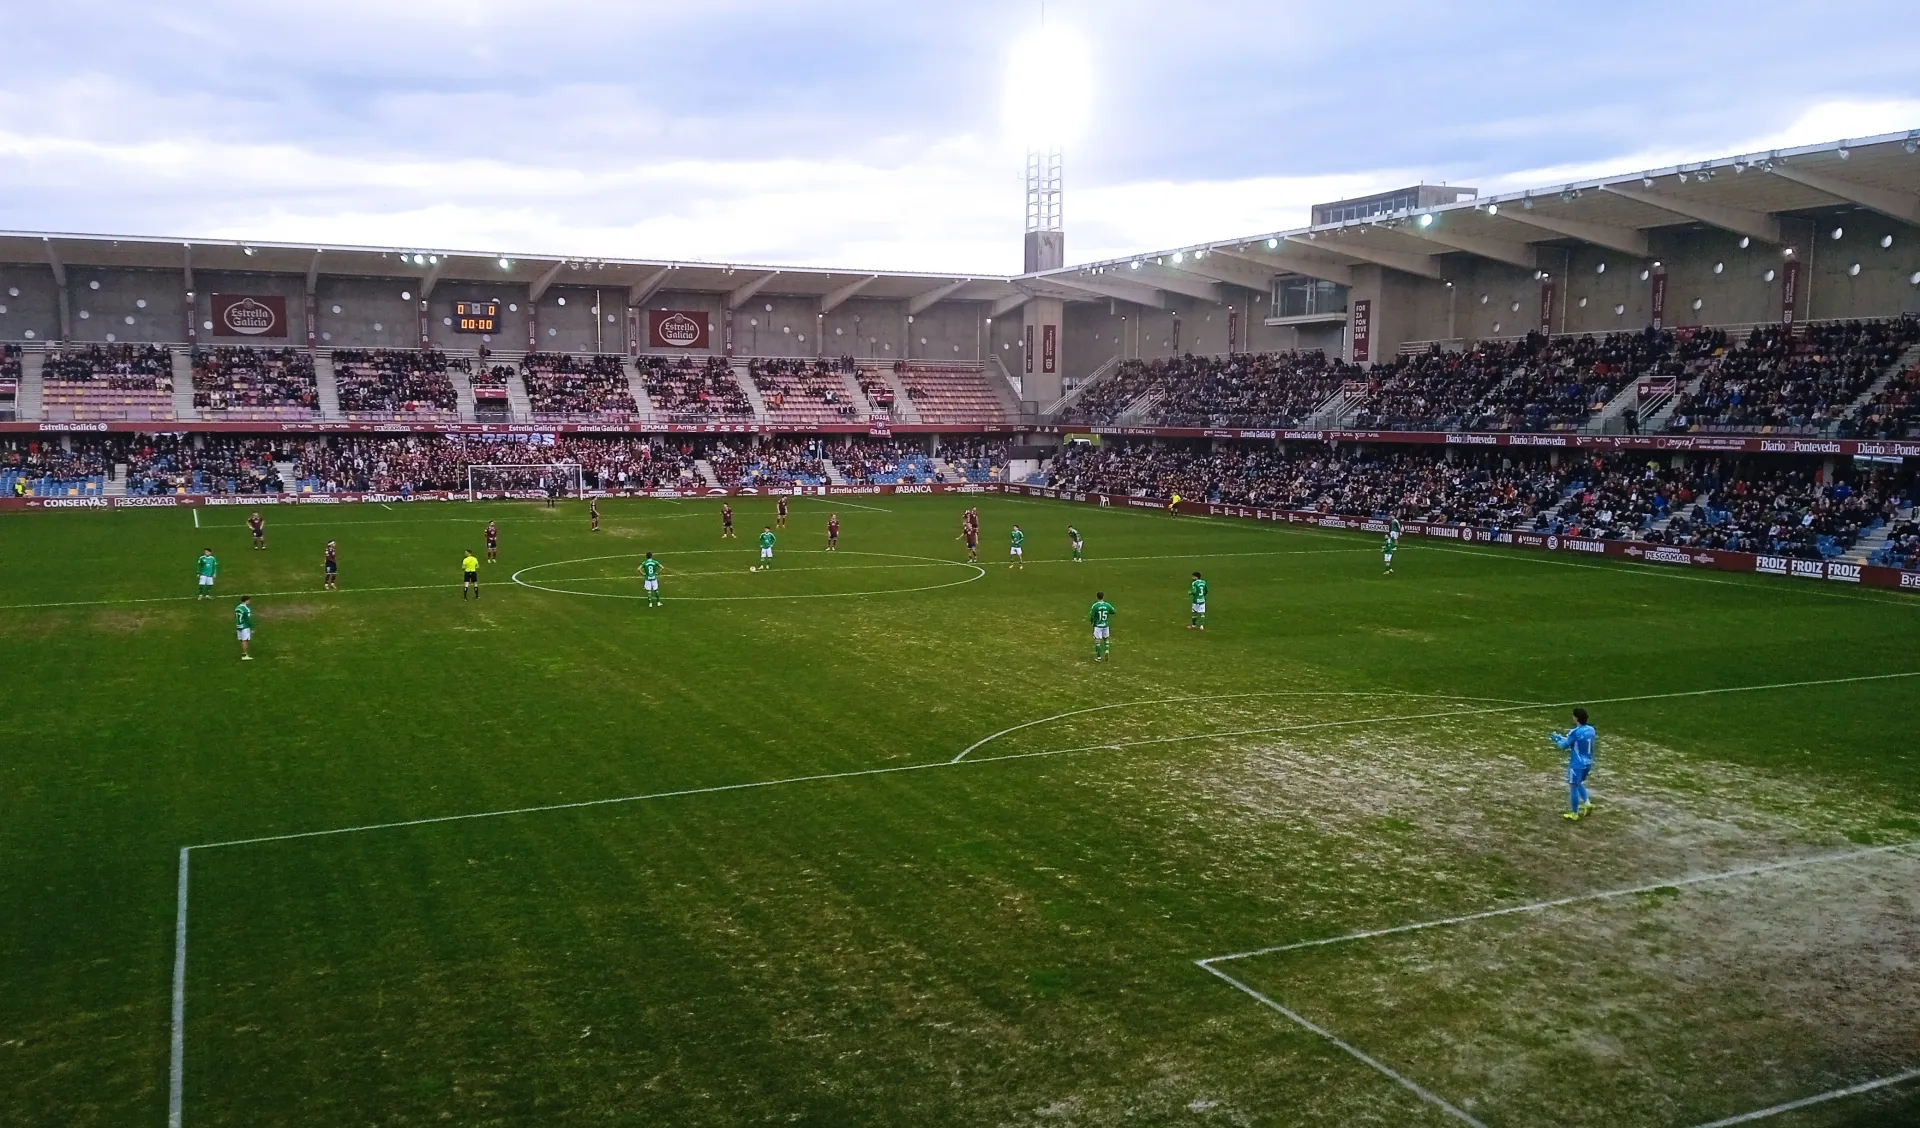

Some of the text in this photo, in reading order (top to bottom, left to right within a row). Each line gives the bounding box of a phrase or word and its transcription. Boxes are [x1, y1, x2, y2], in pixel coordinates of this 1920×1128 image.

[231, 308, 268, 319] Estrella
[457, 304, 464, 315] 0
[488, 305, 495, 316] 0
[233, 317, 267, 327] Galicia
[664, 322, 695, 331] Estrella
[1355, 318, 1366, 326] PON
[1355, 325, 1367, 333] TEVE
[666, 330, 693, 340] Galicia
[40, 423, 69, 431] Estrella
[508, 424, 556, 432] Estrella Galicia
[1240, 430, 1256, 438] Estrella
[1302, 431, 1317, 439] Galicia
[1446, 434, 1462, 443] Diario
[1467, 435, 1496, 444] Pontevedra
[1509, 435, 1527, 445] Diario
[1533, 436, 1566, 446] Pontevedra
[1760, 440, 1785, 451] Diario
[1793, 442, 1840, 453] Pontevedra
[1857, 443, 1885, 454] Diario
[830, 486, 852, 494] Estrella
[897, 485, 933, 493] ABANCA
[44, 499, 108, 508] CONSERVAS
[115, 497, 178, 506] PESCAMAR
[204, 497, 228, 505] Diario
[235, 495, 278, 505] Pontevedra
[1361, 522, 1390, 532] PESCAMAR
[1482, 532, 1512, 543] FEDACIÓN
[1522, 536, 1543, 544] VERSUS
[1569, 540, 1605, 552] FEDERACIÓN
[1645, 550, 1692, 564] PESCAMAR
[1756, 556, 1787, 570] FROIZ
[1791, 559, 1823, 574] FROIZ
[648, 565, 654, 575] 8
[1828, 563, 1861, 578] FROIZ
[1198, 586, 1204, 596] 3
[1098, 610, 1108, 621] 15
